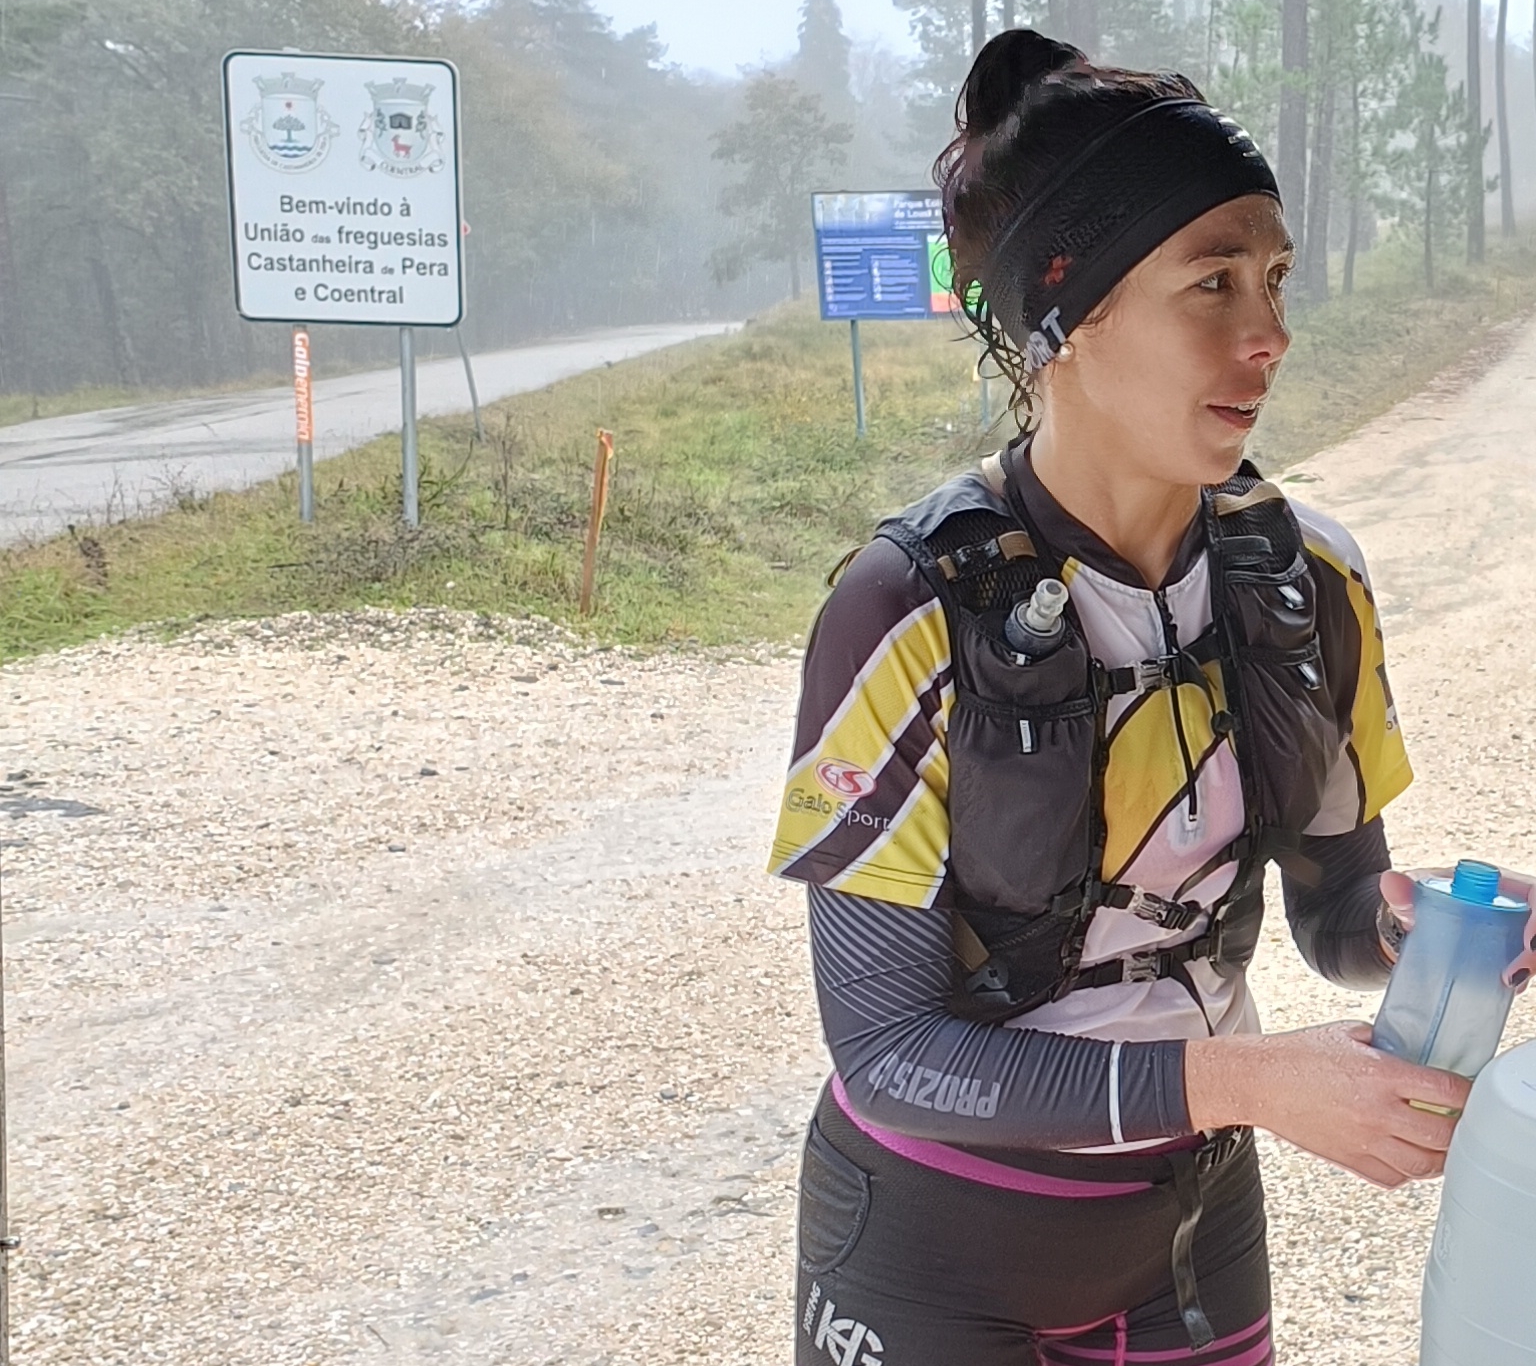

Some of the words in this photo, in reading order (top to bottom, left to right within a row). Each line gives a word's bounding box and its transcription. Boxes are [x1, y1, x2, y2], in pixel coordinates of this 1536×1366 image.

[280, 195, 393, 216] Bem-vindo
[400, 197, 411, 217] à
[244, 222, 304, 243] União
[311, 234, 331, 244] das
[337, 225, 449, 249] freguesias
[247, 252, 374, 274] Castanheira
[381, 264, 395, 275] de
[402, 257, 449, 277] Pera
[294, 287, 306, 301] e
[313, 283, 404, 305] Coentral
[787, 787, 833, 815] Galo
[834, 800, 891, 832] Sport
[888, 1060, 1001, 1119] PROZIS
